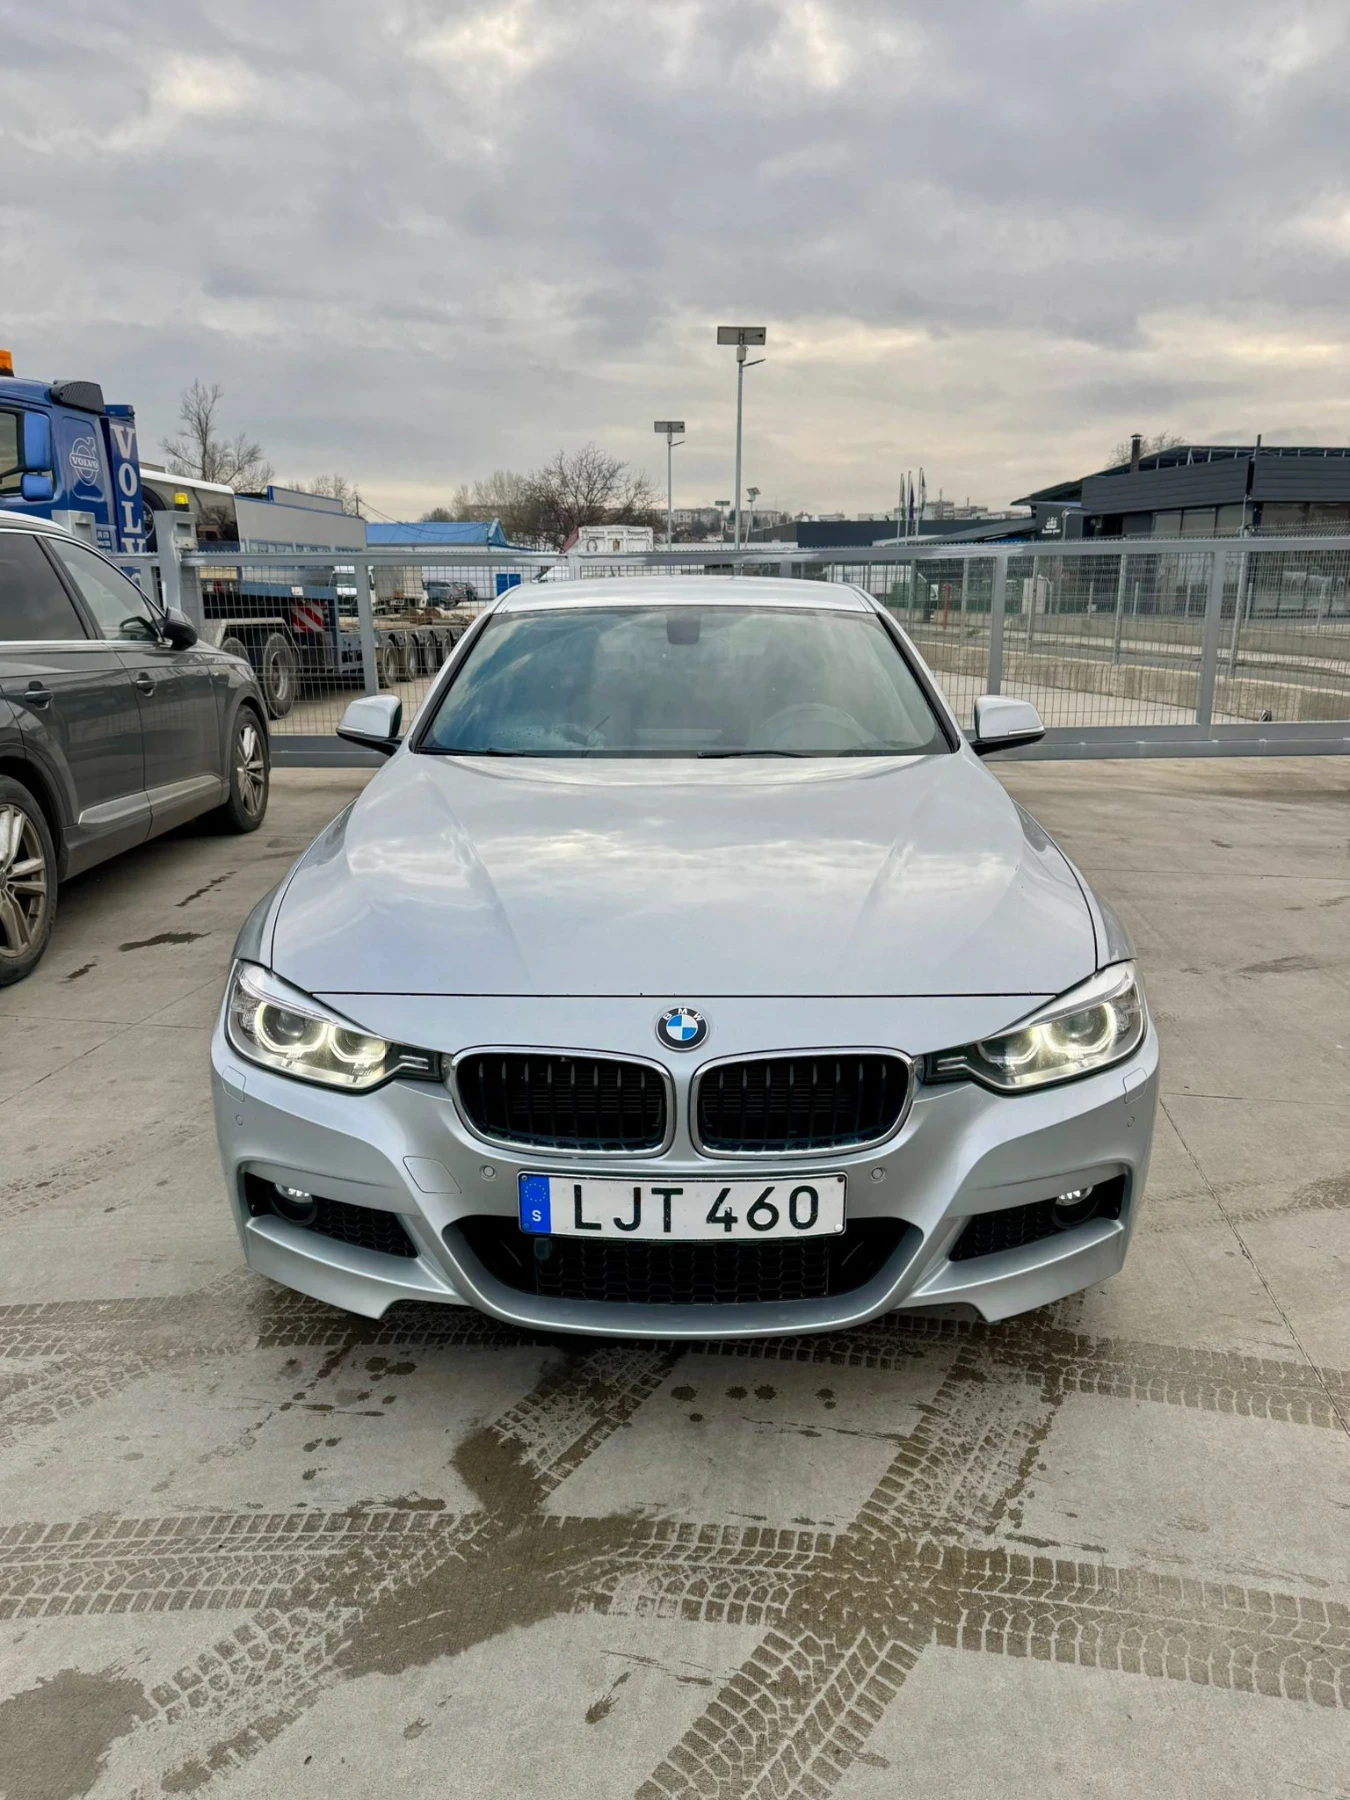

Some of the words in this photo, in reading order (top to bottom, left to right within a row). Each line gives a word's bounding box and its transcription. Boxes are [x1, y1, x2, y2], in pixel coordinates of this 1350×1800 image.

[71, 456, 98, 468] VOLVO
[662, 1008, 704, 1021] BMW
[573, 1184, 684, 1233] LJT
[706, 1185, 819, 1232] 460
[532, 1209, 542, 1222] S
